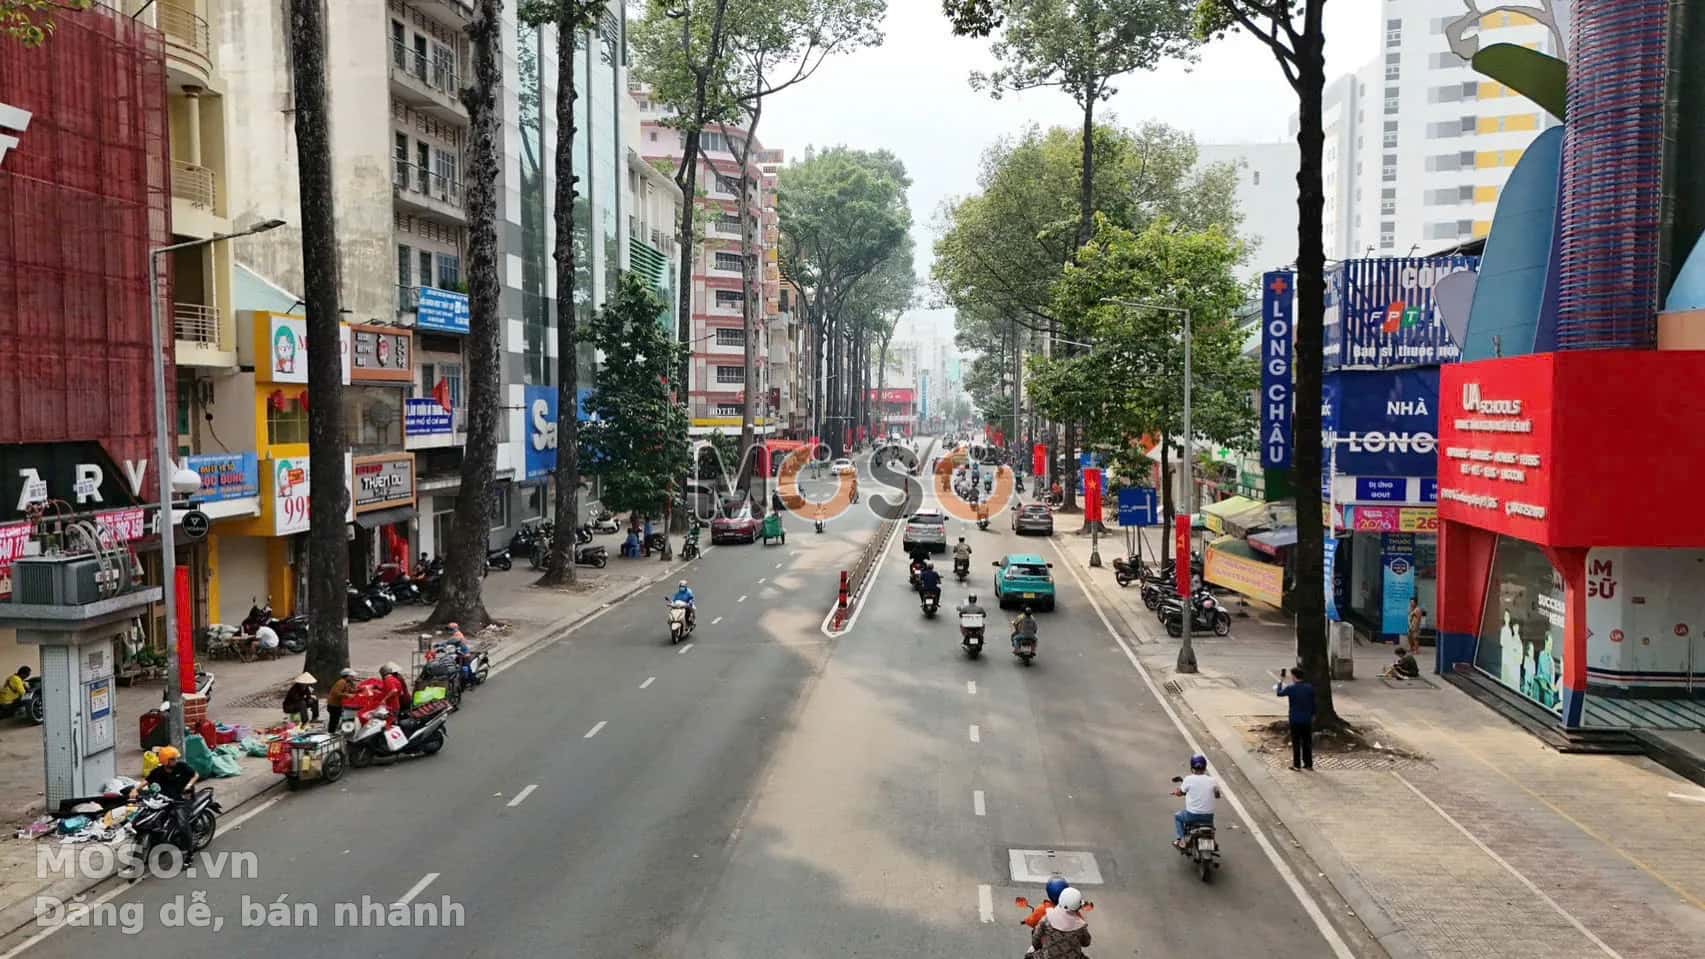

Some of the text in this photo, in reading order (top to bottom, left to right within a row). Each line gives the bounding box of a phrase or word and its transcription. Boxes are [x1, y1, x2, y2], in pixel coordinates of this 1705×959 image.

[1268, 302, 1287, 462] LONG CHÂU
[1387, 398, 1428, 416] NHÀ
[1350, 431, 1435, 454] LONG
